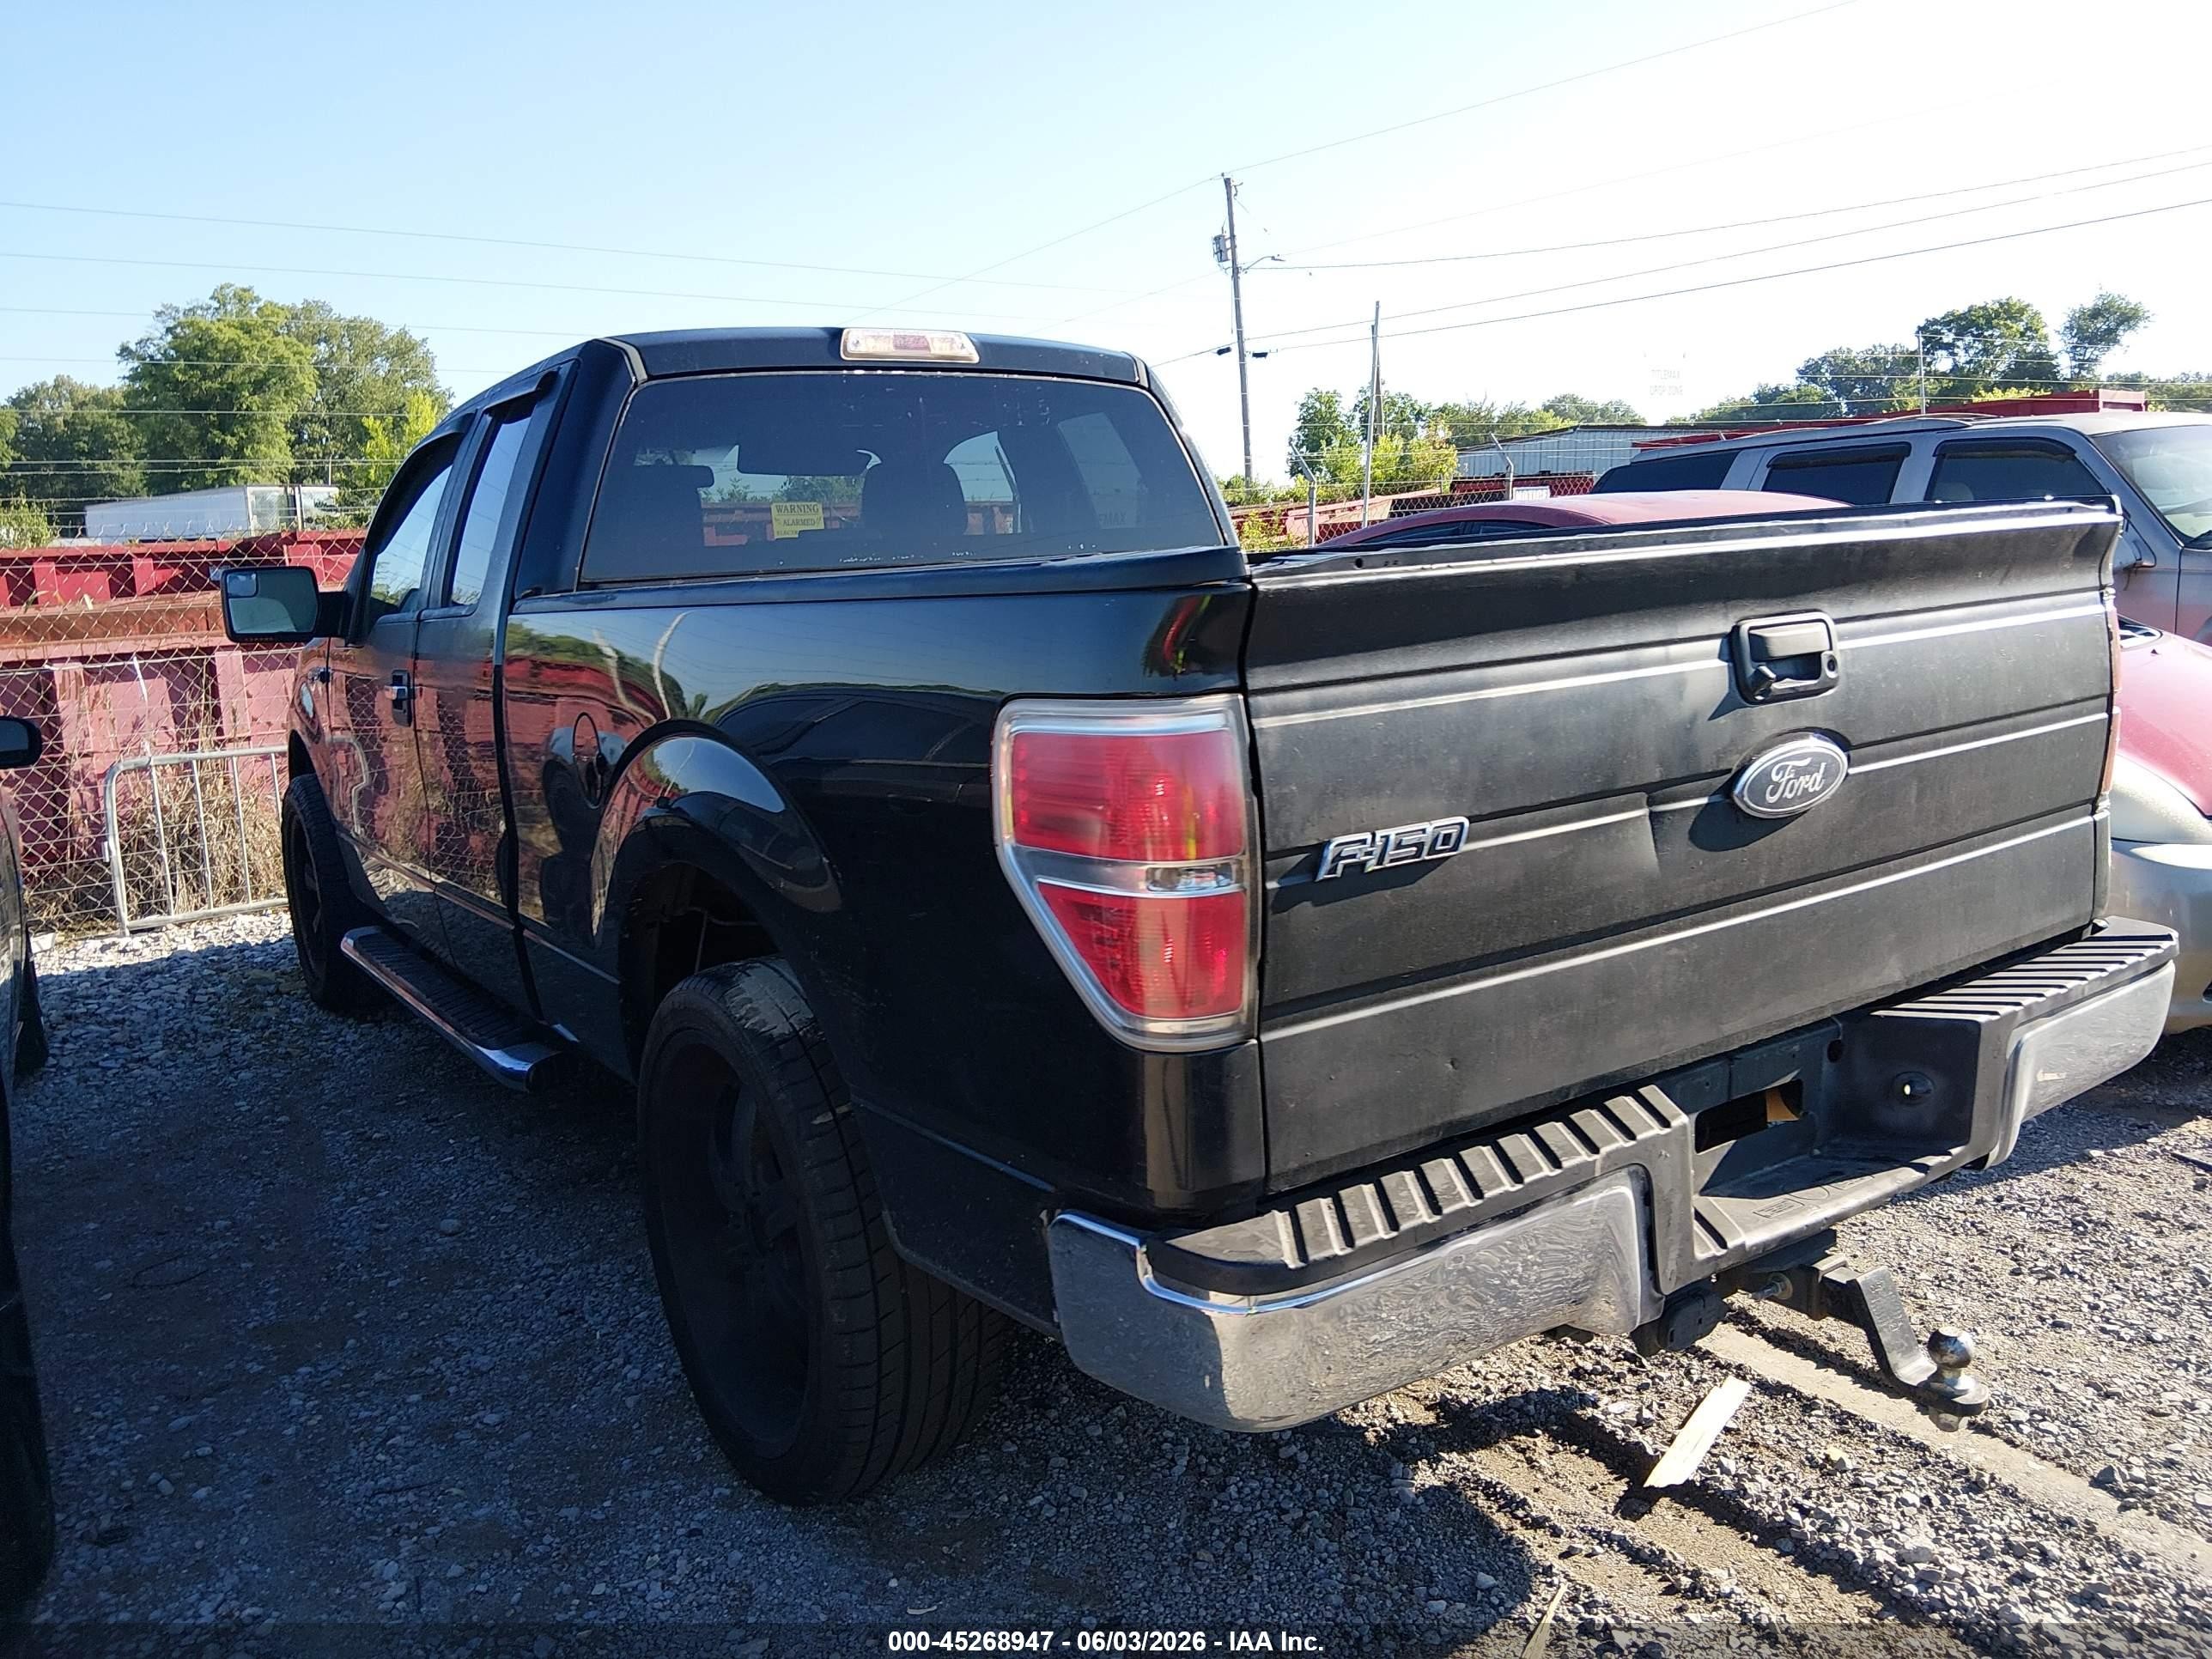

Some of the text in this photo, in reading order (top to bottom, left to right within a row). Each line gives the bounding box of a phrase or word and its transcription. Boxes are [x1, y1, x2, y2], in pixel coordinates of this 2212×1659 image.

[1516, 489, 1547, 501] NOTICE
[775, 504, 819, 514] WARNING
[783, 518, 816, 527] ALARMED
[1765, 757, 1827, 804] Ford
[1315, 816, 1470, 882] F-150
